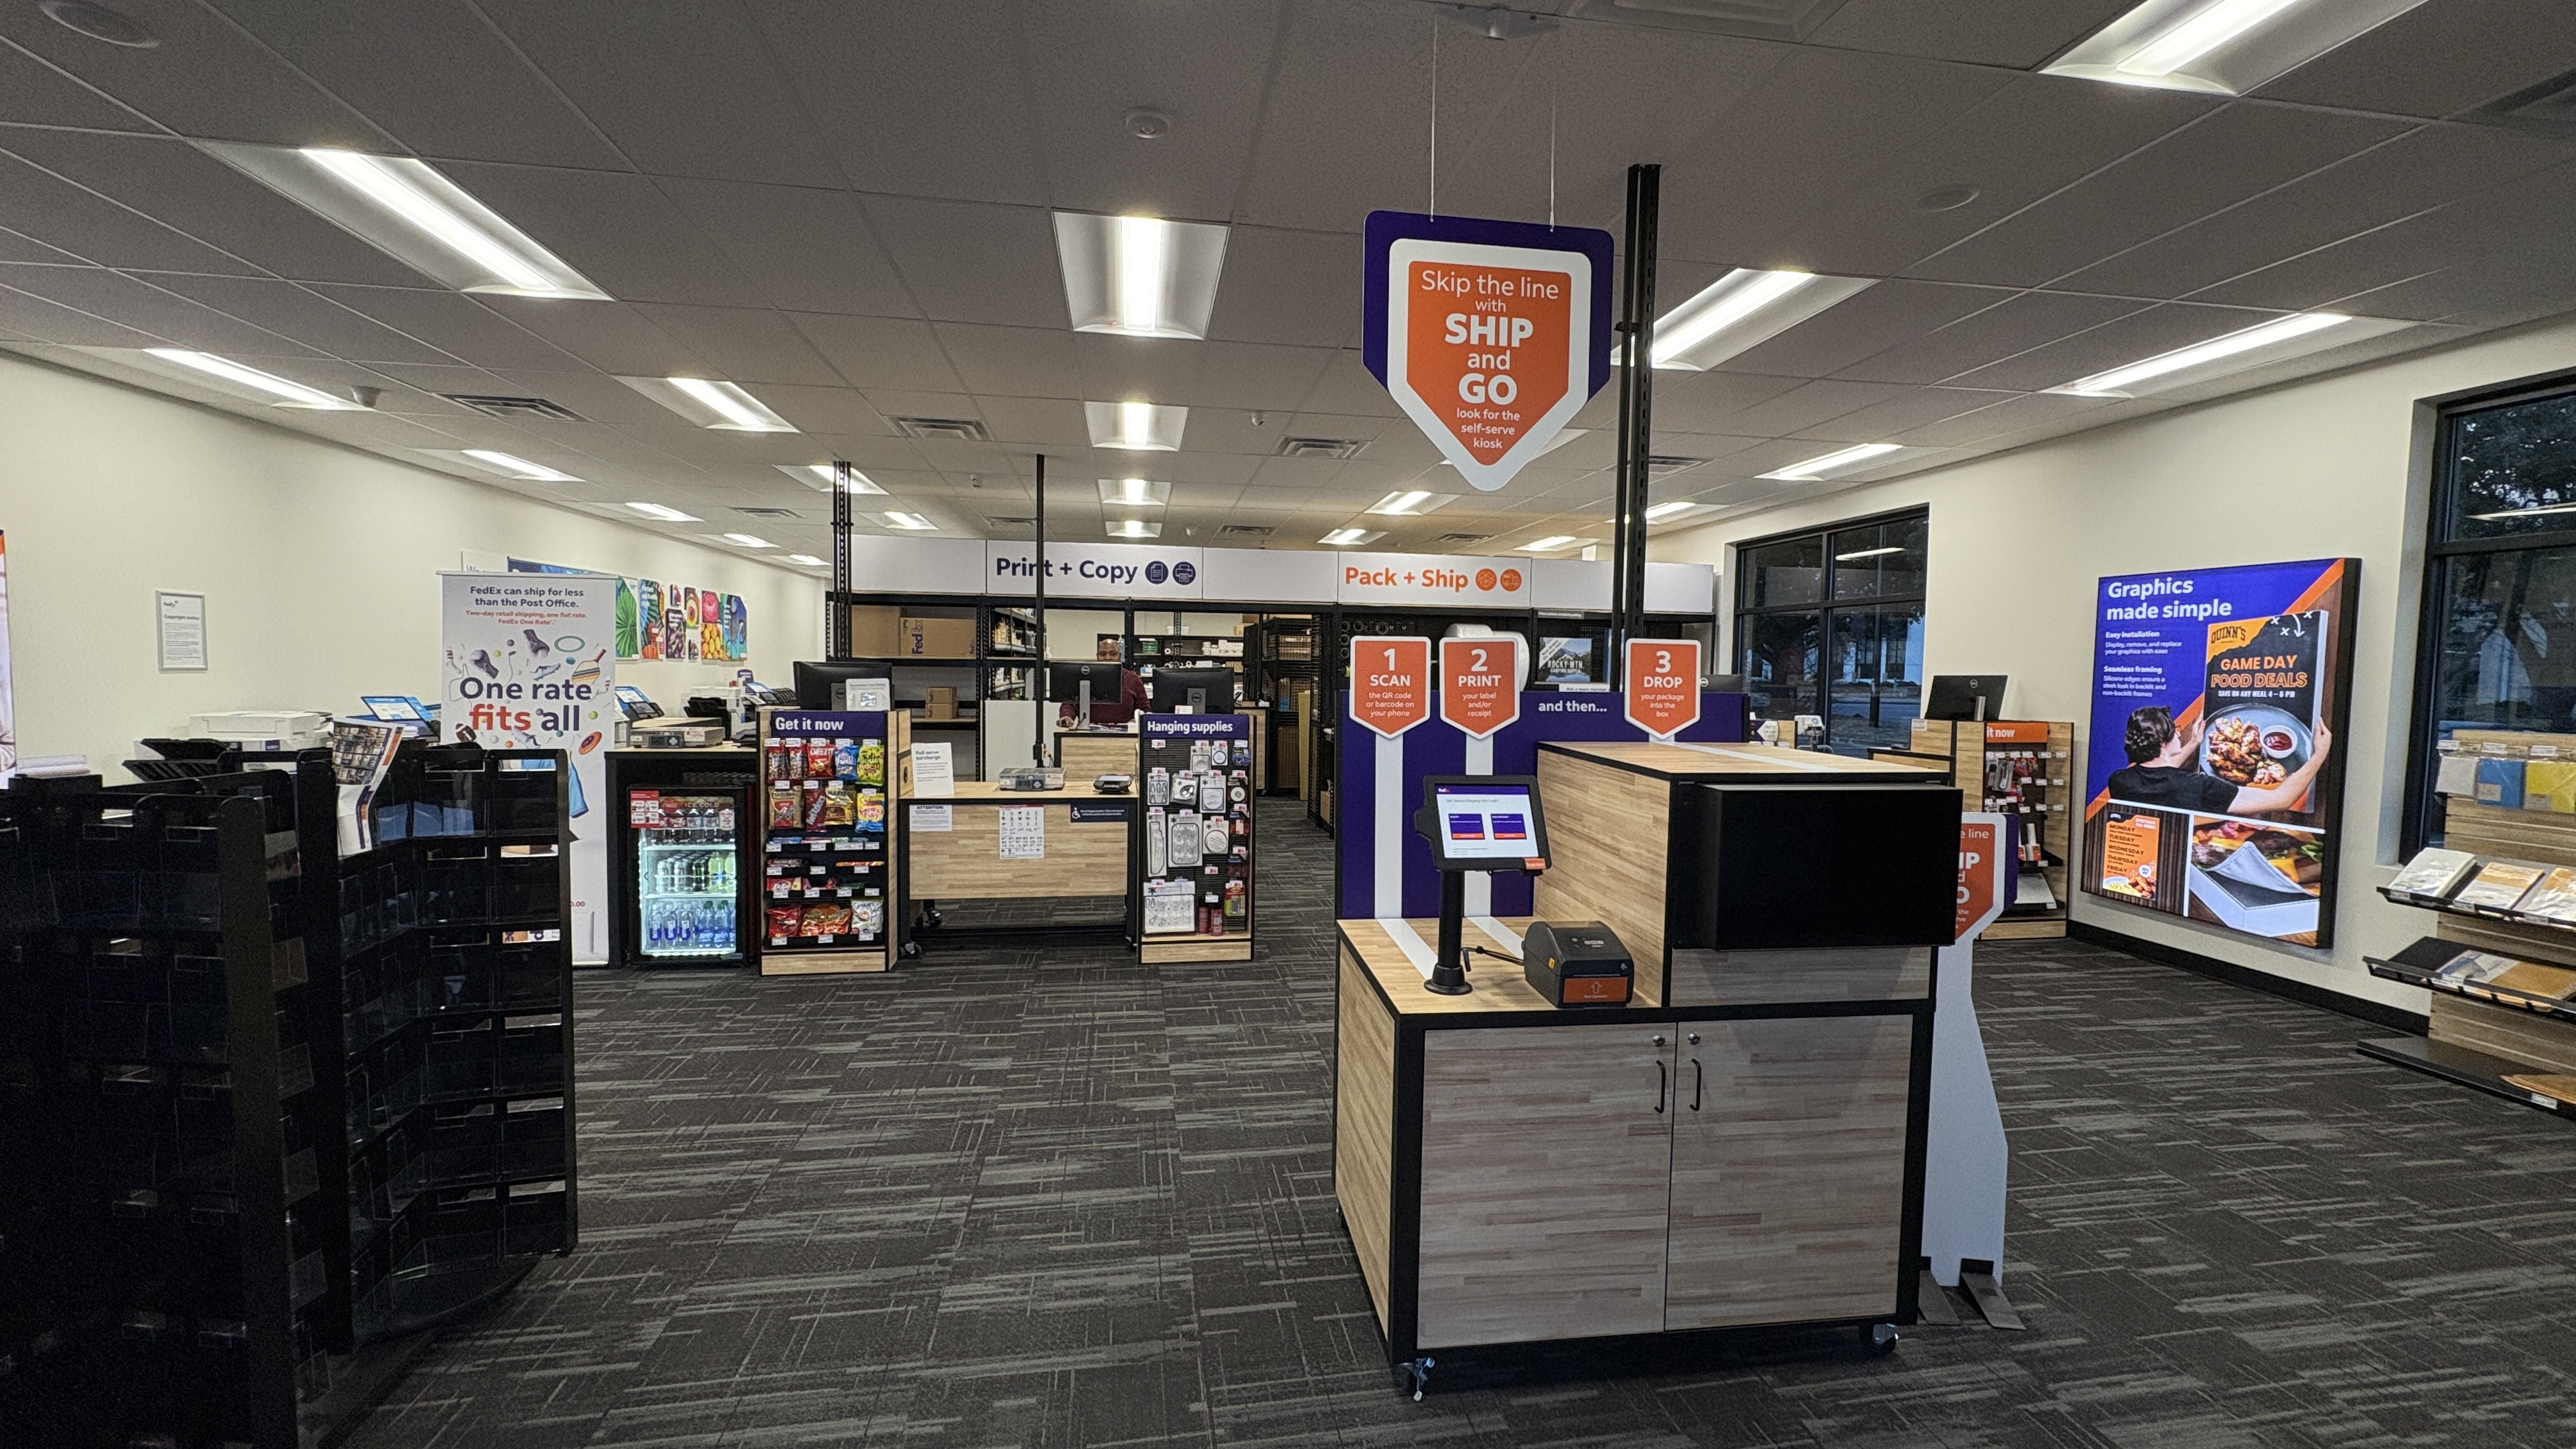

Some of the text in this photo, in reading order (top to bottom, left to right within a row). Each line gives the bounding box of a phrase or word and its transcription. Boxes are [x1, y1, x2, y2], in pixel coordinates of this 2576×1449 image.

[1422, 270, 1559, 300] Skip the line
[1475, 298, 1506, 312] with
[1445, 313, 1533, 347] SHIP
[1467, 350, 1511, 370] and
[1459, 373, 1517, 405] GO
[1457, 408, 1521, 421] look for the
[1460, 424, 1515, 435] self-serve
[1473, 438, 1503, 448] kiosk
[996, 557, 1138, 584] Print + Copy
[1346, 567, 1469, 592] Pack + Ship
[470, 586, 502, 595] FedEx
[524, 587, 546, 597] ship
[548, 588, 563, 596] for
[565, 588, 584, 597] less
[2108, 577, 2194, 601] Graphics
[475, 597, 579, 608] than the Post Office.
[2107, 598, 2232, 621] made simple
[912, 619, 923, 655] FedEx
[2105, 631, 2121, 640] Easy
[2211, 625, 2246, 644] QUINN'S
[1383, 648, 1395, 671] 1
[1471, 648, 1488, 672] 2
[1547, 660, 1585, 669] ROCKY MTN.
[1655, 650, 1671, 673] 3
[2221, 655, 2297, 670] GAME DAY
[2135, 666, 2162, 674] framing
[1370, 675, 1411, 687] SCAN
[1458, 675, 1501, 687] PRINT
[1643, 676, 1683, 688] DROP
[2211, 671, 2308, 688] FOOD DEALS
[460, 677, 592, 700] One rate
[1657, 693, 1685, 702] package
[1468, 700, 1492, 709] and/or
[1538, 700, 1607, 712] and then...
[469, 703, 580, 731] fits all
[1387, 710, 1410, 718] phone
[1468, 710, 1492, 718] receipt
[776, 717, 844, 730] Get it now
[1147, 721, 1233, 734] Hanging supplies
[1986, 726, 2016, 738] it now
[1968, 829, 1989, 839] line
[2109, 824, 2135, 832] MONDAY
[2109, 834, 2135, 842] TUESDAY
[2108, 844, 2144, 855] WEDNESDAY
[1959, 852, 1981, 870] IP
[2108, 854, 2138, 865] THURSDAY
[2107, 864, 2128, 873] FRIDAY
